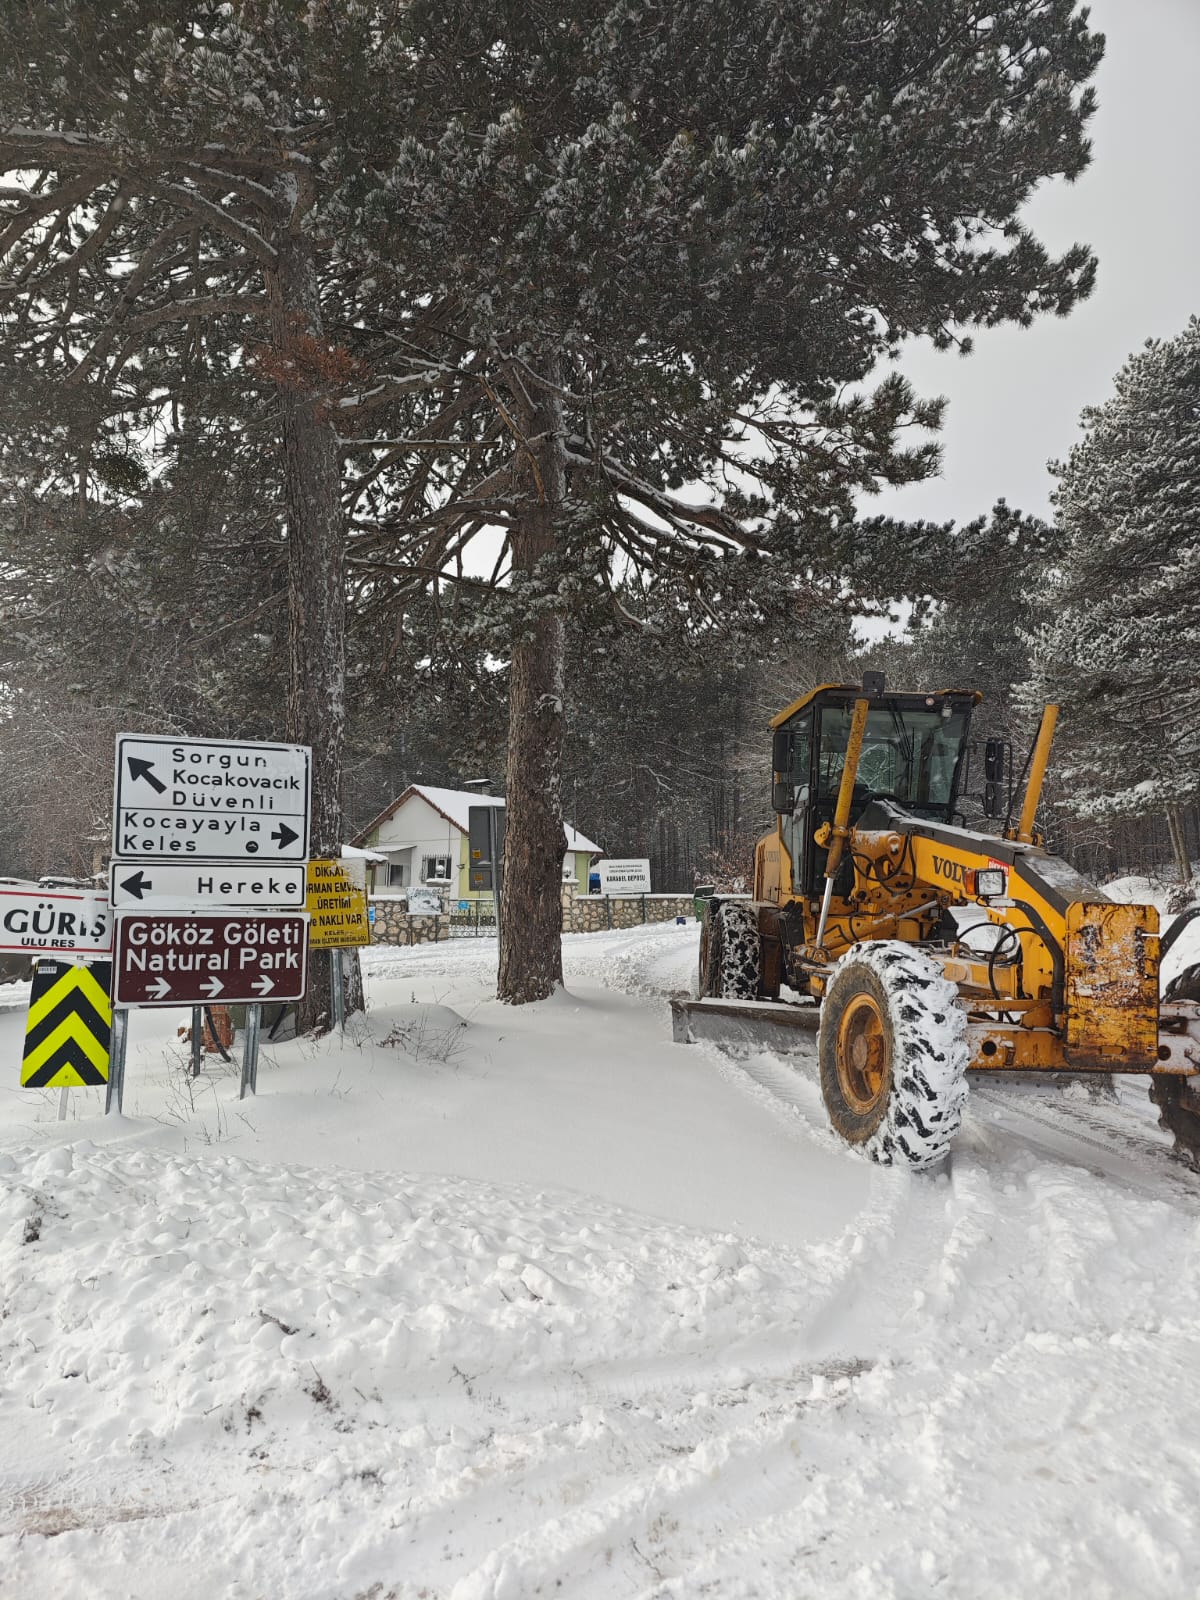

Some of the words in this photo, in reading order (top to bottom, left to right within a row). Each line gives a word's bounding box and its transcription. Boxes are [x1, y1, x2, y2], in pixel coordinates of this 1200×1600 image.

[172, 748, 267, 768] Sorgun
[173, 769, 300, 790] Kocakovacık
[173, 790, 274, 809] Düvenli
[124, 812, 261, 835] Kocayayla
[123, 834, 196, 851] Keles
[932, 855, 972, 883] VOLV
[197, 877, 298, 894] Hereke
[320, 912, 344, 926] NAKLİ
[346, 914, 362, 924] VAR
[21, 937, 47, 947] ULU
[51, 939, 76, 948] RES
[128, 922, 214, 945] Gököz
[223, 922, 299, 945] Göleti
[126, 948, 229, 971] Natural
[239, 947, 299, 969] Park
